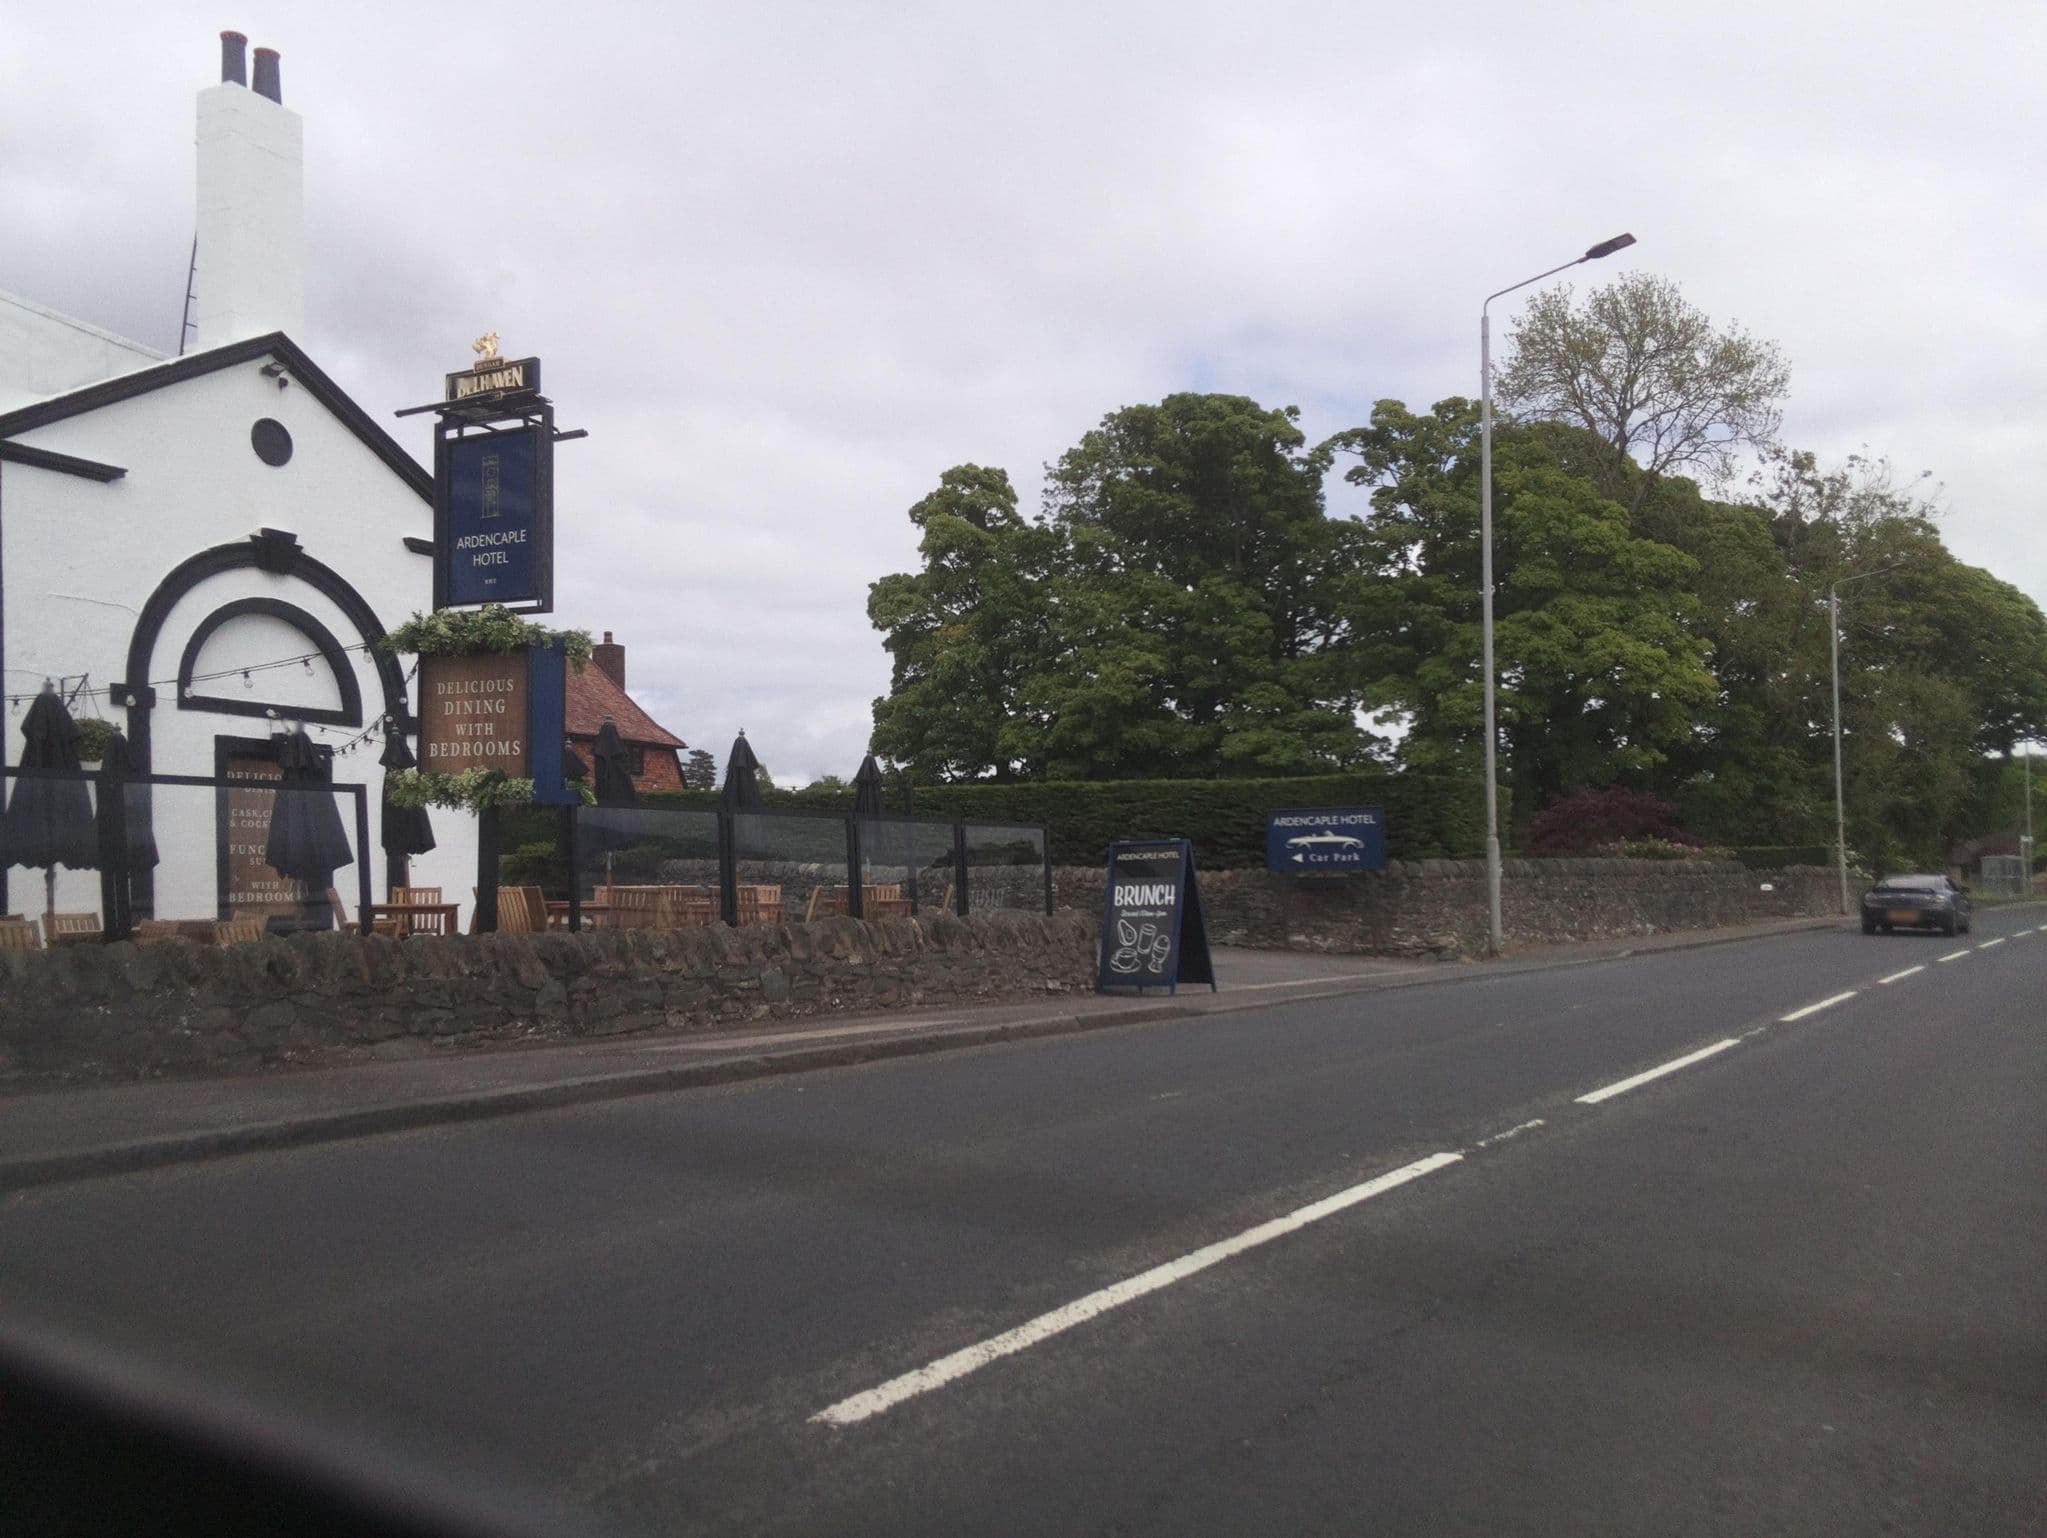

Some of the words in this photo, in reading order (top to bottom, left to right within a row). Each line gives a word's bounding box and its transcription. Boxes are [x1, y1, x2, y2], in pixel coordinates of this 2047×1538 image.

[457, 529, 527, 548] ARDENCAPLE
[473, 551, 509, 567] HOTEL
[437, 679, 514, 695] DELICIOUS
[444, 699, 506, 716] DINING
[455, 723, 494, 736] WITH
[429, 740, 521, 757] BEDROOMS
[1273, 815, 1340, 827] ARDENCAPLE
[1341, 814, 1377, 825] HOTEL
[229, 844, 265, 855] FUNC
[1159, 851, 1180, 860] HOTEL
[1308, 853, 1329, 862] Car
[1333, 852, 1361, 862] Park
[229, 891, 294, 903] BEDROOM
[1114, 884, 1176, 907] BRUNCH
